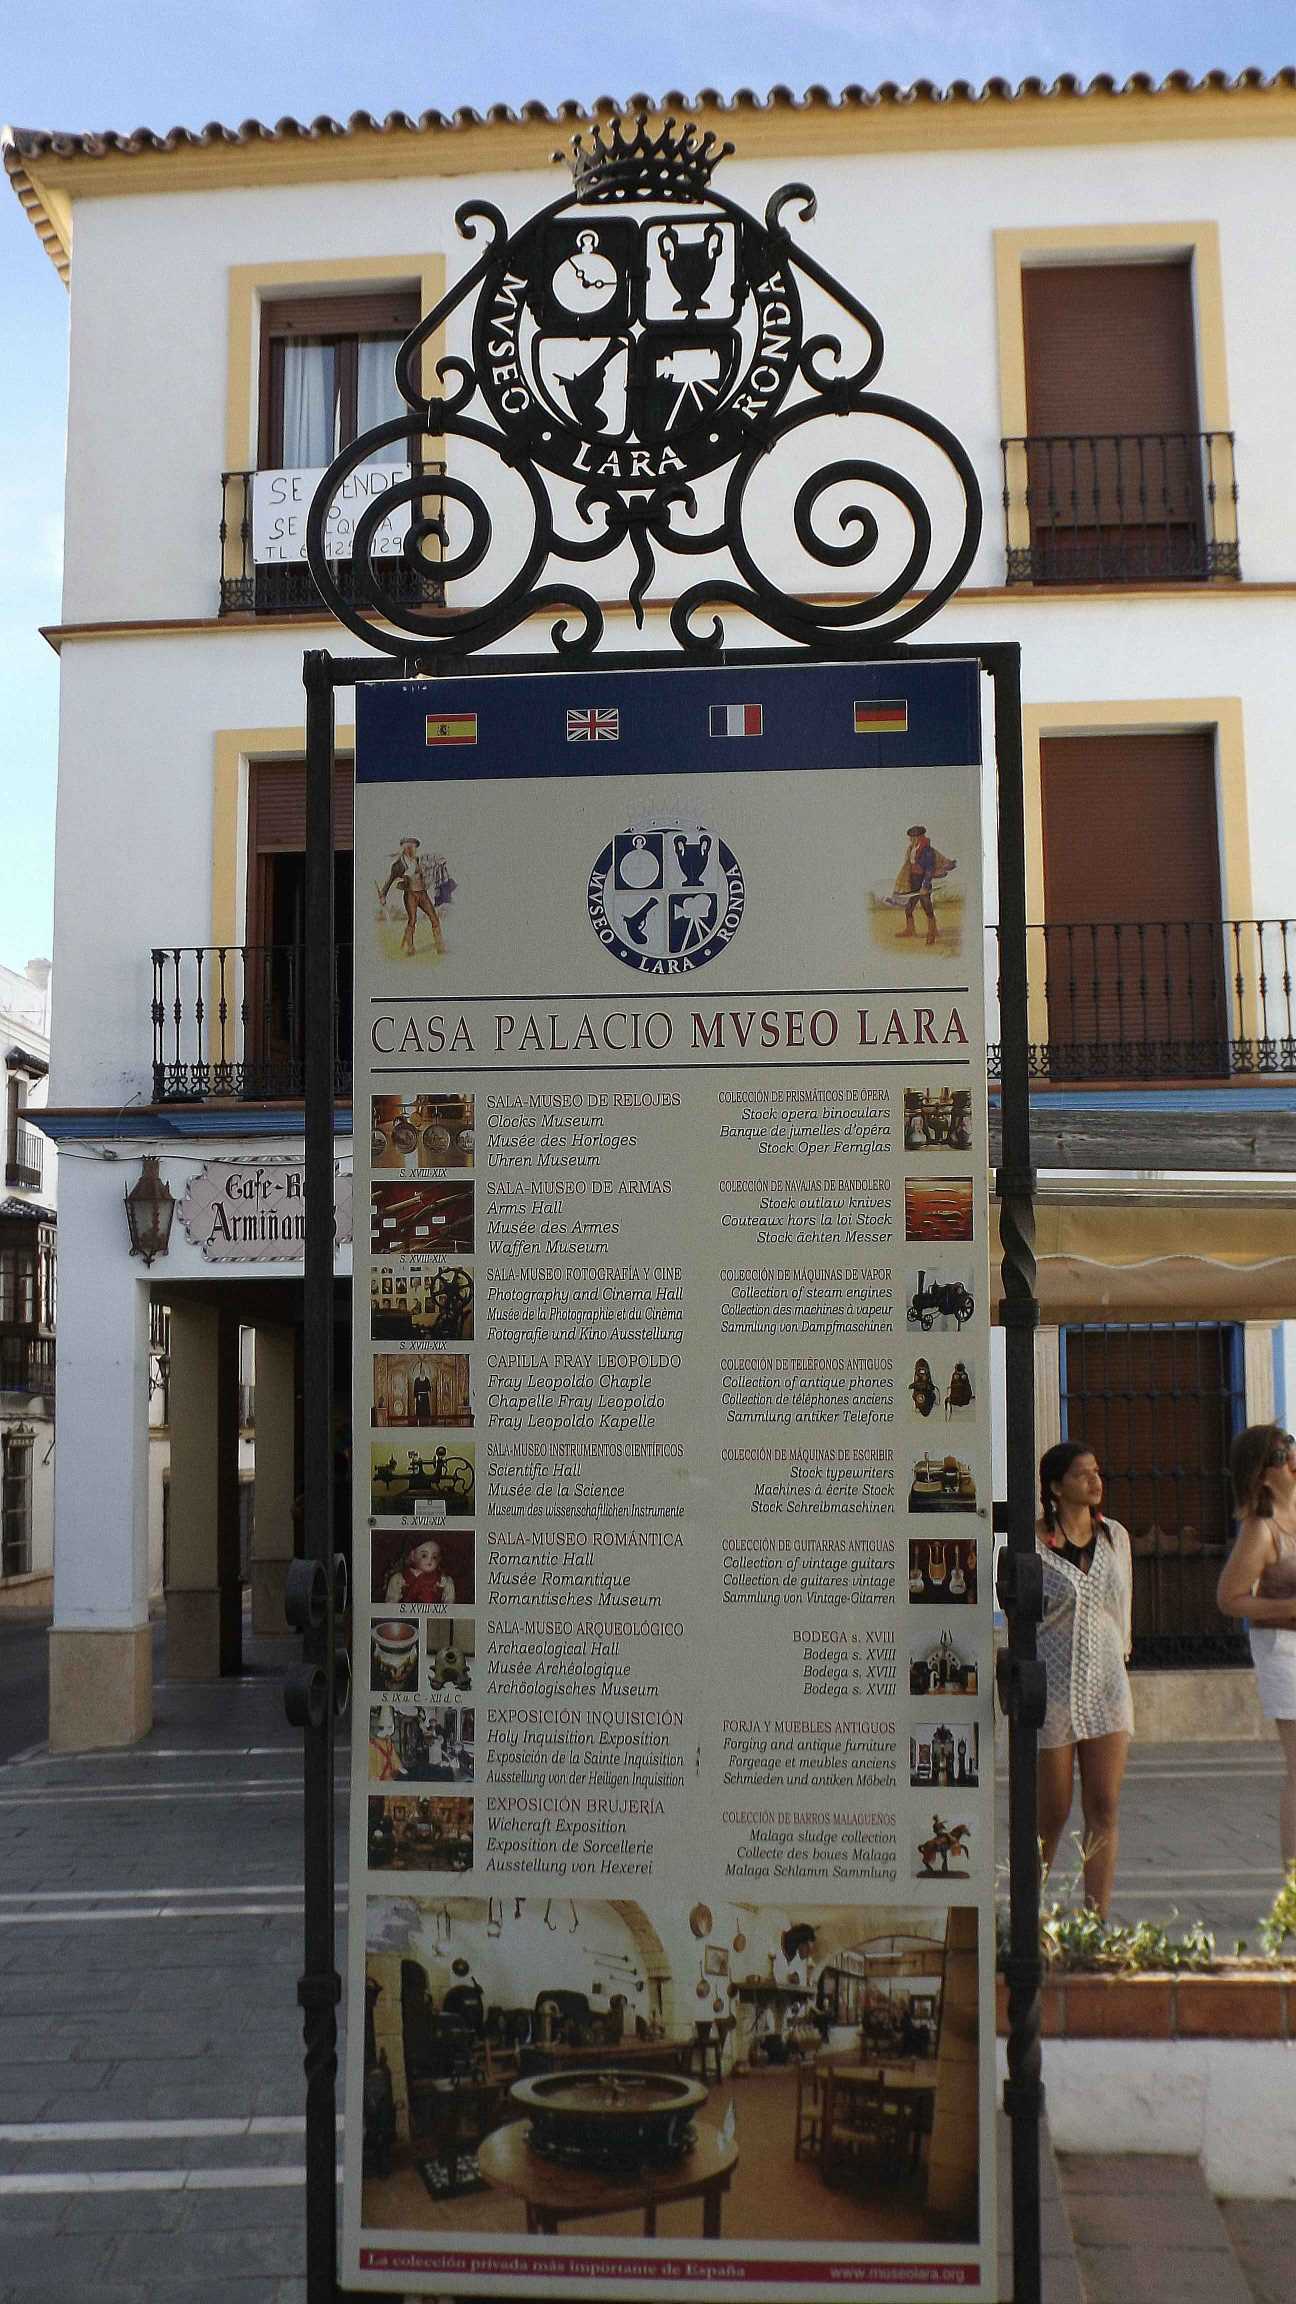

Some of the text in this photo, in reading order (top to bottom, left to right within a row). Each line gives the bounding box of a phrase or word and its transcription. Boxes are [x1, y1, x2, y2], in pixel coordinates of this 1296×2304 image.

[733, 273, 792, 420] RONDA
[572, 439, 688, 477] LARA
[269, 477, 303, 505] SE
[269, 516, 298, 541] SE
[264, 546, 288, 559] TL
[719, 863, 745, 944] RONDA
[638, 955, 697, 976] LARA
[370, 1007, 970, 1055] CASA PALACIO MVSEO LARA
[487, 1093, 681, 1109] SALA-MUSEO DE RELOJES
[487, 1115, 604, 1128] Clocks Museum
[742, 1108, 890, 1122] Stock opera binoculars
[720, 1125, 767, 1140] Banque
[771, 1125, 787, 1136] de
[788, 1125, 840, 1139] jumelles
[487, 1134, 637, 1149] Musée des Horloges
[488, 1153, 600, 1167] Uhren Museum
[487, 1180, 671, 1195] SALA-MUSEO DE ARMAS
[487, 1201, 563, 1214] Arms Hall
[760, 1197, 892, 1209] Stock outlaw knives
[487, 1219, 619, 1234] Musée des Armes
[722, 1213, 892, 1226] Couteaux hors la loi Stock
[489, 1240, 608, 1256] Waffen Museum
[486, 1266, 681, 1280] SALA-MUSEO FOTOGRAFÍA Y CINE
[488, 1287, 682, 1304] Photography and Cinema Hall
[731, 1287, 892, 1301] Collection of steam engines
[488, 1327, 683, 1343] Fotografie und Kino Ausstellung
[487, 1354, 681, 1368] CAPILLA FRAY LEOPOLDO
[488, 1374, 651, 1391] Fray Leopoldo Chaple
[722, 1376, 894, 1391] Collection of antique phones
[488, 1395, 664, 1410] Chapelle Fray Leopoldo
[488, 1415, 655, 1431] Fray Leopoldo Kapelle
[726, 1410, 893, 1425] Sammlung antiker Telefone
[488, 1463, 581, 1479] Scientific Hall
[791, 1466, 894, 1481] Stock typewriters
[488, 1483, 625, 1497] Musée de la Science
[751, 1501, 894, 1513] Stock Schreibmaschinen
[488, 1530, 683, 1546] SALA-MUSEO ROMÁNTICA
[489, 1552, 594, 1565] Romantic Hall
[723, 1556, 895, 1572] Collection of vintage guitars
[488, 1572, 630, 1589] Musée Romantique
[489, 1592, 661, 1606] Romantisches Museum
[793, 1631, 847, 1643] BODEGA
[865, 1632, 895, 1643] XVIII
[487, 1641, 619, 1658] Archaeological Hall
[804, 1648, 848, 1662] Bodega
[866, 1649, 895, 1660] XVIII
[487, 1662, 630, 1679] Musée Archéologique
[723, 1720, 895, 1733] FORJA Y MUEBLES ANTIGUOS
[487, 1731, 669, 1749] Holy Inquisition Exposition
[723, 1738, 767, 1752] Forging
[771, 1738, 793, 1750] and
[797, 1739, 841, 1754] antique
[556, 1819, 626, 1836] Exposition
[487, 1838, 557, 1854] Exposition
[562, 1839, 578, 1852] de
[486, 1858, 652, 1876] Ausstellung von Hexerei
